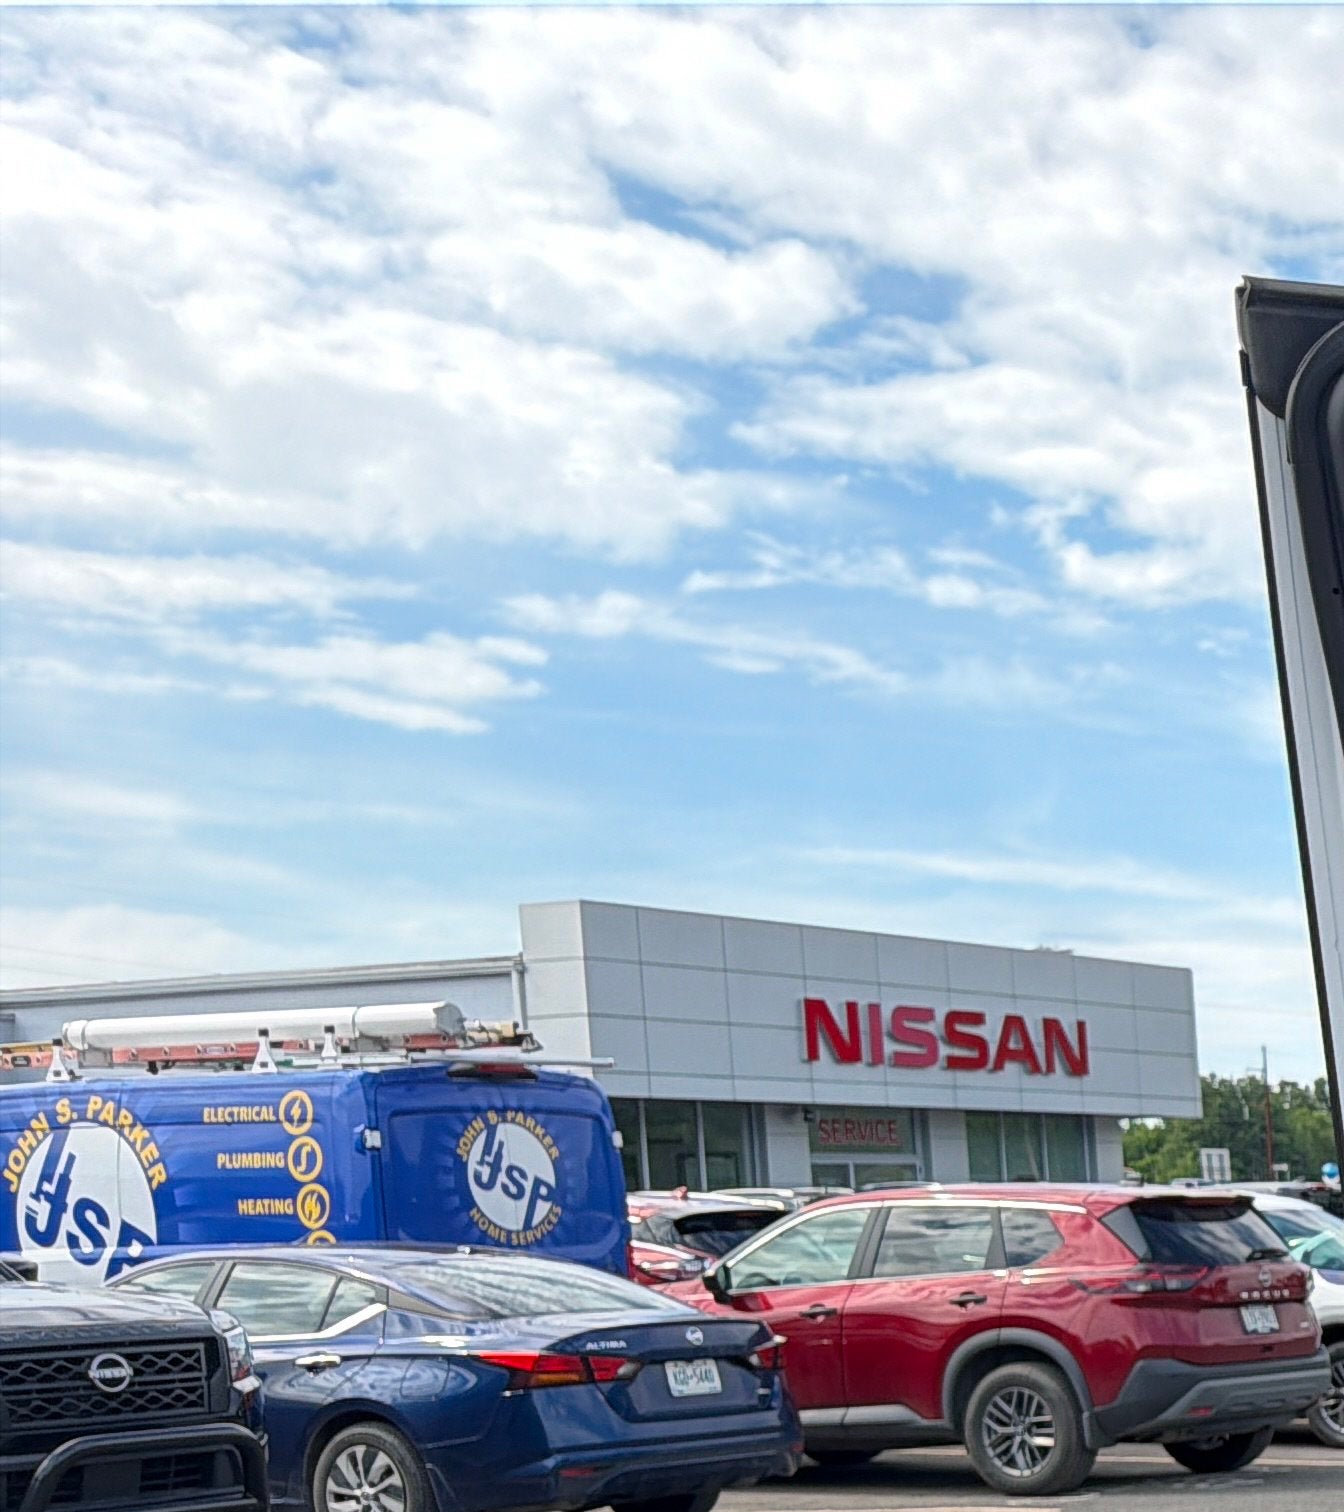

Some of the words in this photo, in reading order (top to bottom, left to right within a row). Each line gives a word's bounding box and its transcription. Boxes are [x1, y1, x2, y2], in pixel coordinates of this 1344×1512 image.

[803, 997, 1090, 1077] NISSAN
[203, 1105, 277, 1123] ELECTRICAL
[3, 1112, 50, 1193] JOHN
[55, 1098, 78, 1124] S.
[86, 1095, 167, 1190] PARKER
[456, 1115, 485, 1162] JOHN
[506, 1110, 560, 1160] PARKER
[818, 1118, 899, 1146] SERVICE
[217, 1152, 286, 1170] PLUMBING
[238, 1199, 294, 1215] HEATING
[470, 1207, 507, 1245] HOME
[511, 1205, 562, 1246] SERVICES
